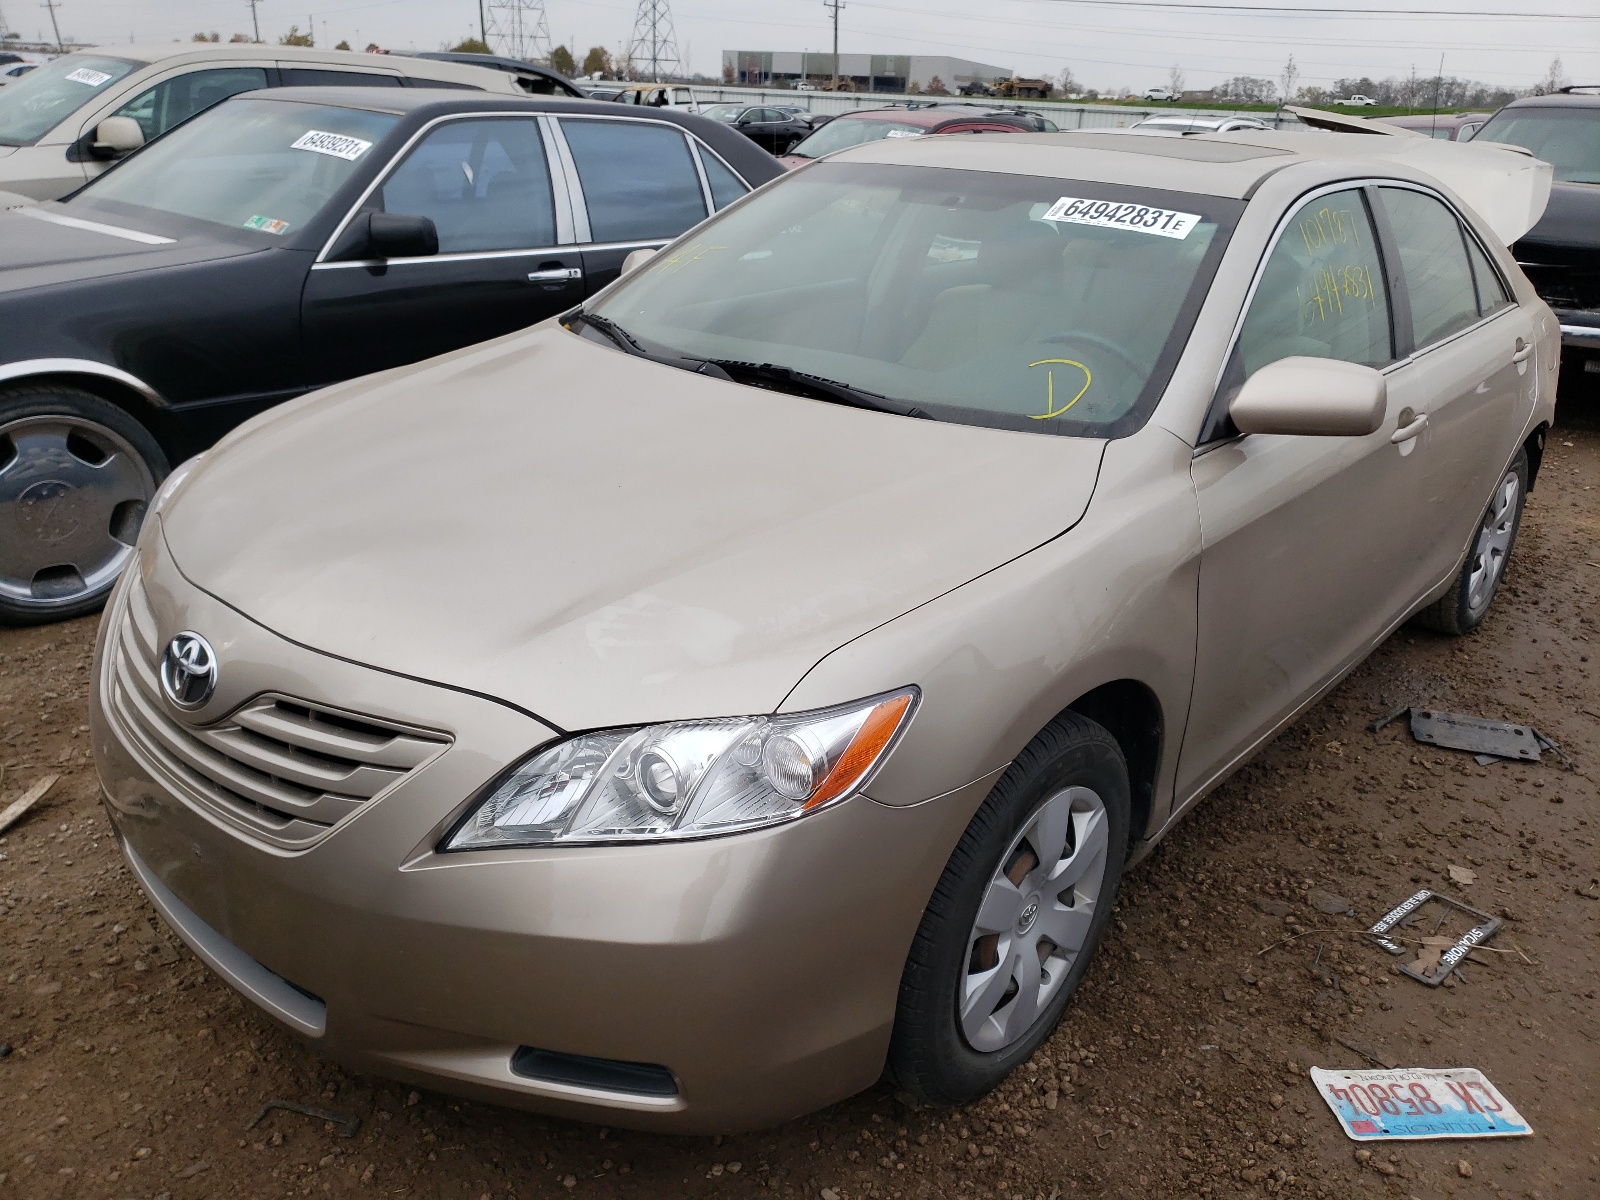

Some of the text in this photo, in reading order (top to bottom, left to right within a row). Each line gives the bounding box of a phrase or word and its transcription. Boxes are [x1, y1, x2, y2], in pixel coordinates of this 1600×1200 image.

[1064, 200, 1177, 230] 64942831
[1172, 220, 1186, 231] E
[1026, 358, 1092, 420] D
[1443, 928, 1484, 965] SYCAMORE
[1328, 1081, 1503, 1116] CK 85804
[1394, 1123, 1481, 1134] ILLINOIS
